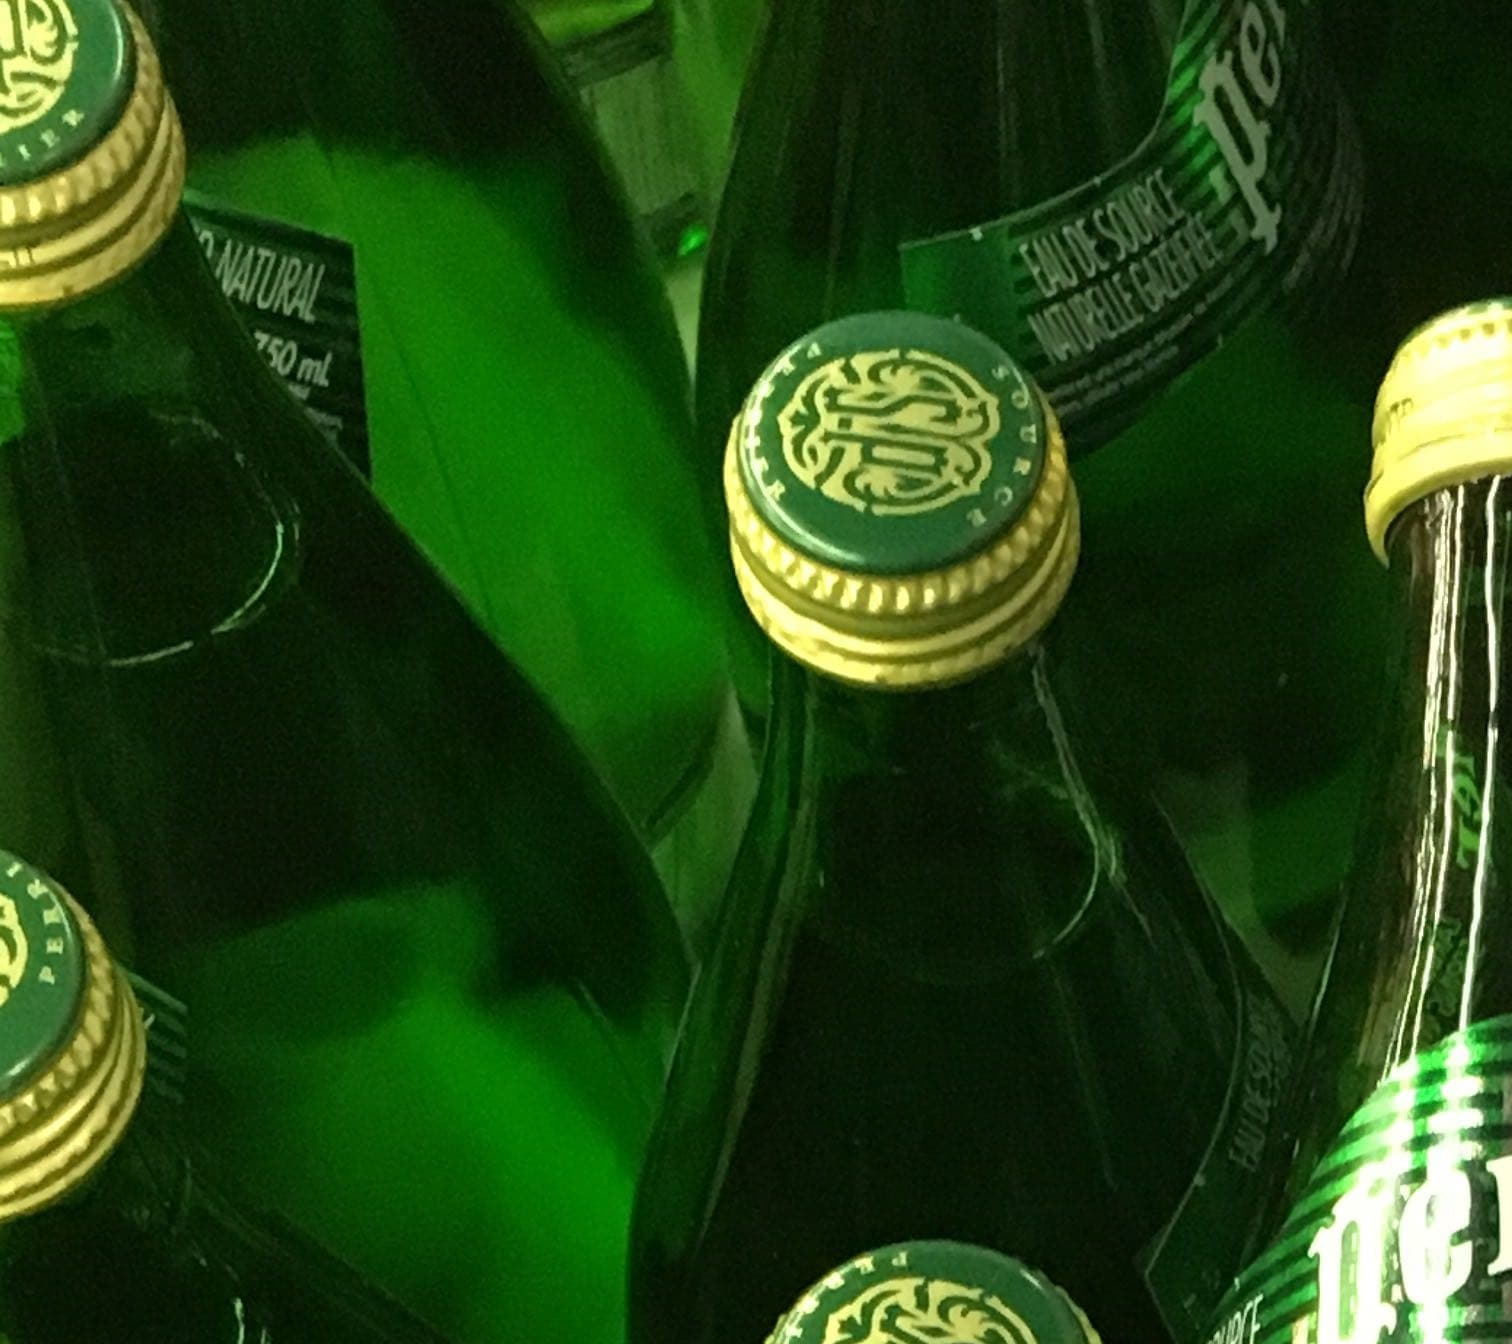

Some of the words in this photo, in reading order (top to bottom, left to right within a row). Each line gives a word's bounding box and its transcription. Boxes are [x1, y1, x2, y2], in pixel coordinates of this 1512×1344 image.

[214, 239, 326, 324] NATURAL
[1019, 233, 1079, 298] EAU
[1062, 218, 1110, 279] DE
[1093, 168, 1185, 262] SOURCE
[1027, 272, 1145, 367] NATURELLE
[966, 364, 1039, 530] SOURCE
